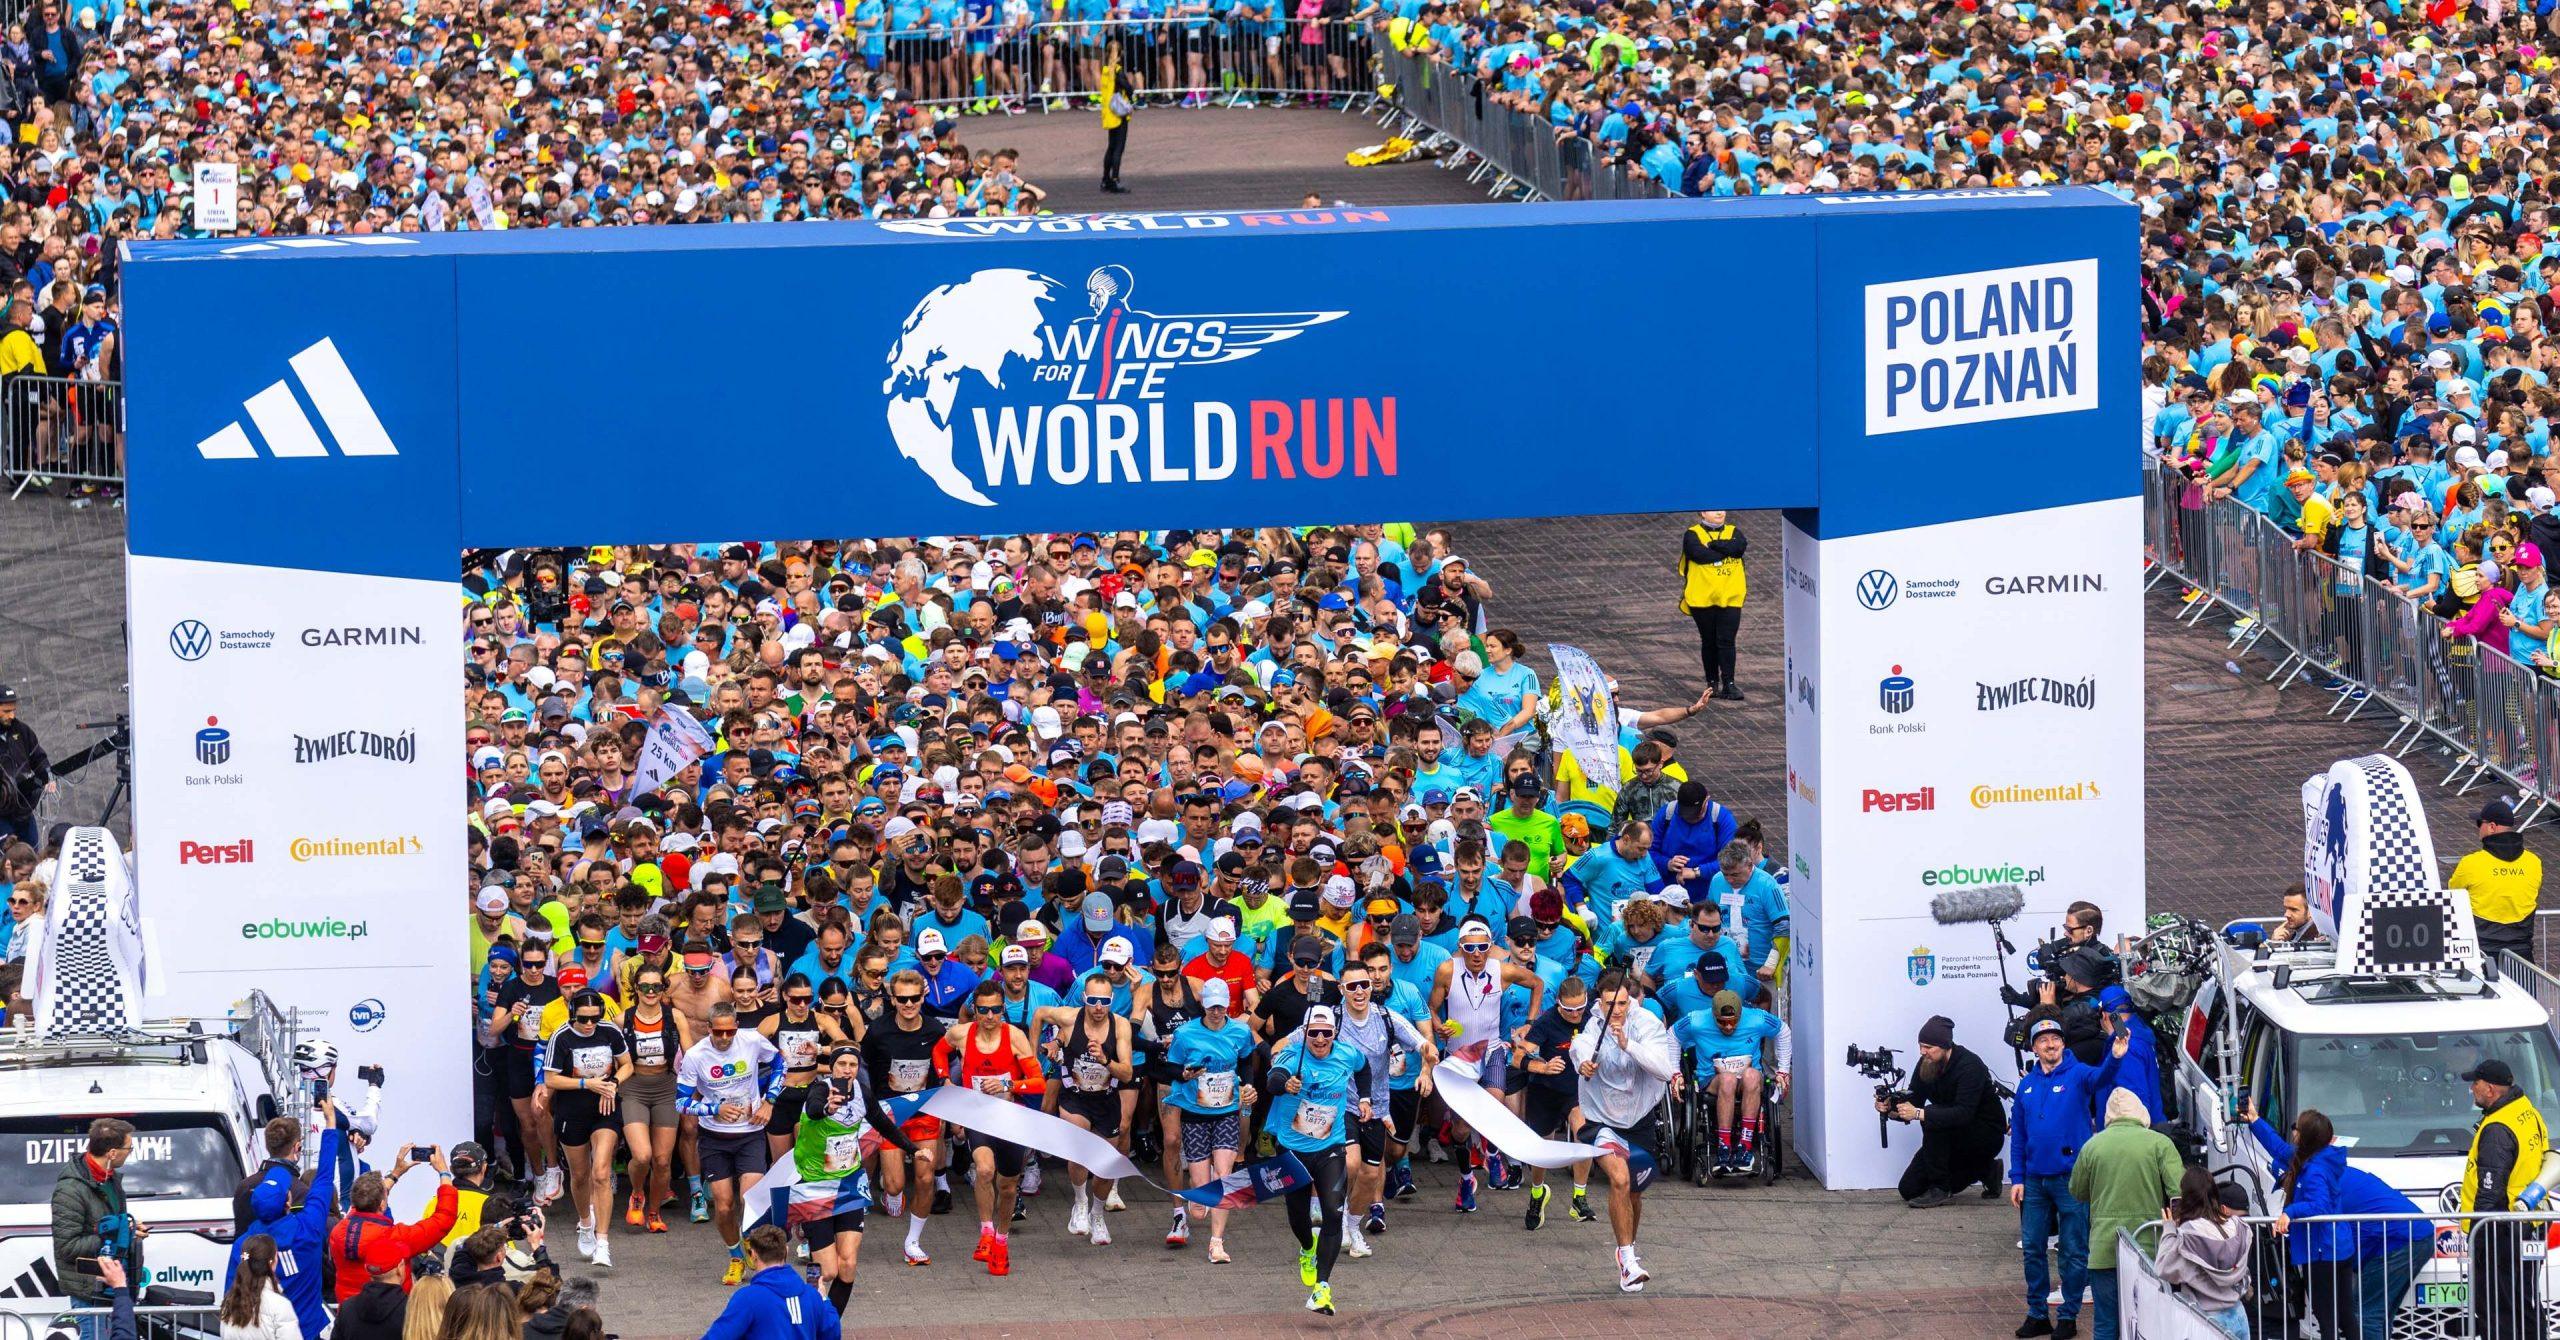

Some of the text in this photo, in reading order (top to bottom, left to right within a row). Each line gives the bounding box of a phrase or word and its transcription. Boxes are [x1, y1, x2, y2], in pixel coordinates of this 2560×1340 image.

[963, 210, 1390, 236] WORLD RUN
[1887, 276, 2073, 350] POLAND
[1044, 309, 1229, 361] WINGS
[1033, 362, 1176, 400] FOR LIFE
[1887, 329, 2076, 418] POZNAŃ
[972, 396, 1397, 486] WORLD RUN
[1716, 568, 1732, 576] 245
[1905, 579, 1960, 590] Samochody
[1905, 589, 1956, 599] Dostawcze
[1985, 573, 2103, 595] GARMIN
[219, 629, 276, 640] Samochody
[301, 626, 421, 647] GARMIN
[219, 640, 272, 650] Dostawcze
[1976, 675, 2095, 711] ŻYWIEC ZDRÓJ
[1869, 723, 1926, 735] Bank Polski
[293, 728, 416, 764] ŻYWIEC ZDRÓJ
[651, 742, 677, 773] 25 km
[185, 774, 243, 786] Bank Polski
[1862, 782, 2083, 813] Persil Continental
[180, 836, 405, 865] Persil Continental
[1922, 862, 2045, 886] eobuwie.pl
[2492, 867, 2525, 877] SOWA
[242, 916, 368, 941] eobuwie.pl
[2386, 923, 2430, 948] 0.0
[1941, 955, 1971, 963] Patronat
[2453, 944, 2470, 954] km
[1941, 964, 1981, 972] Prezydenta
[583, 1062, 605, 1070] 18232
[1723, 1061, 1744, 1070] 17725
[1305, 1116, 1327, 1126] 18179
[2445, 1244, 2469, 1253] WORL
[156, 1266, 214, 1286] allwyn
